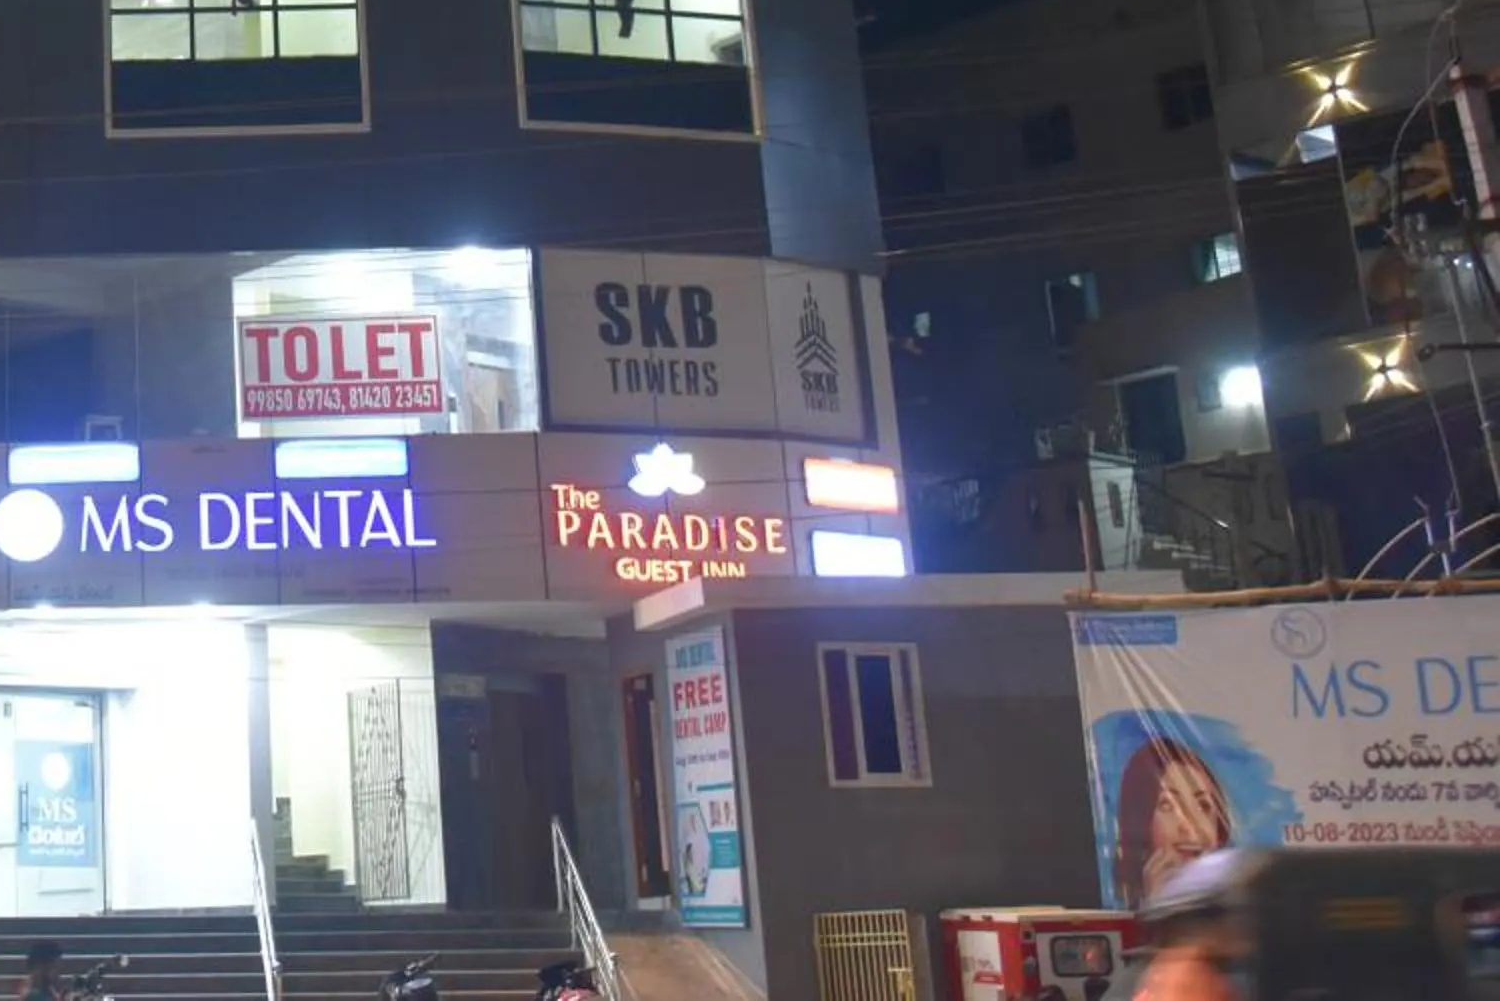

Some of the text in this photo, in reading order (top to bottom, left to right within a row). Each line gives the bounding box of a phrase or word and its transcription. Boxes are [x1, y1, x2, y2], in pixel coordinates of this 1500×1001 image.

[594, 282, 718, 349] SKB
[245, 323, 432, 383] TO LET
[606, 357, 719, 397] TOWERS
[800, 370, 838, 394] SKB
[247, 390, 293, 412] 99850
[350, 386, 390, 408] 81420
[395, 384, 438, 407] 23451
[550, 484, 600, 510] The
[80, 488, 437, 552] MS DENTAL
[557, 510, 787, 553] PARADISE
[616, 557, 746, 582] GUEST INN
[673, 674, 723, 711] FREE
[1291, 654, 1500, 719] MS DE
[1283, 821, 1400, 844] 10-08-2023
